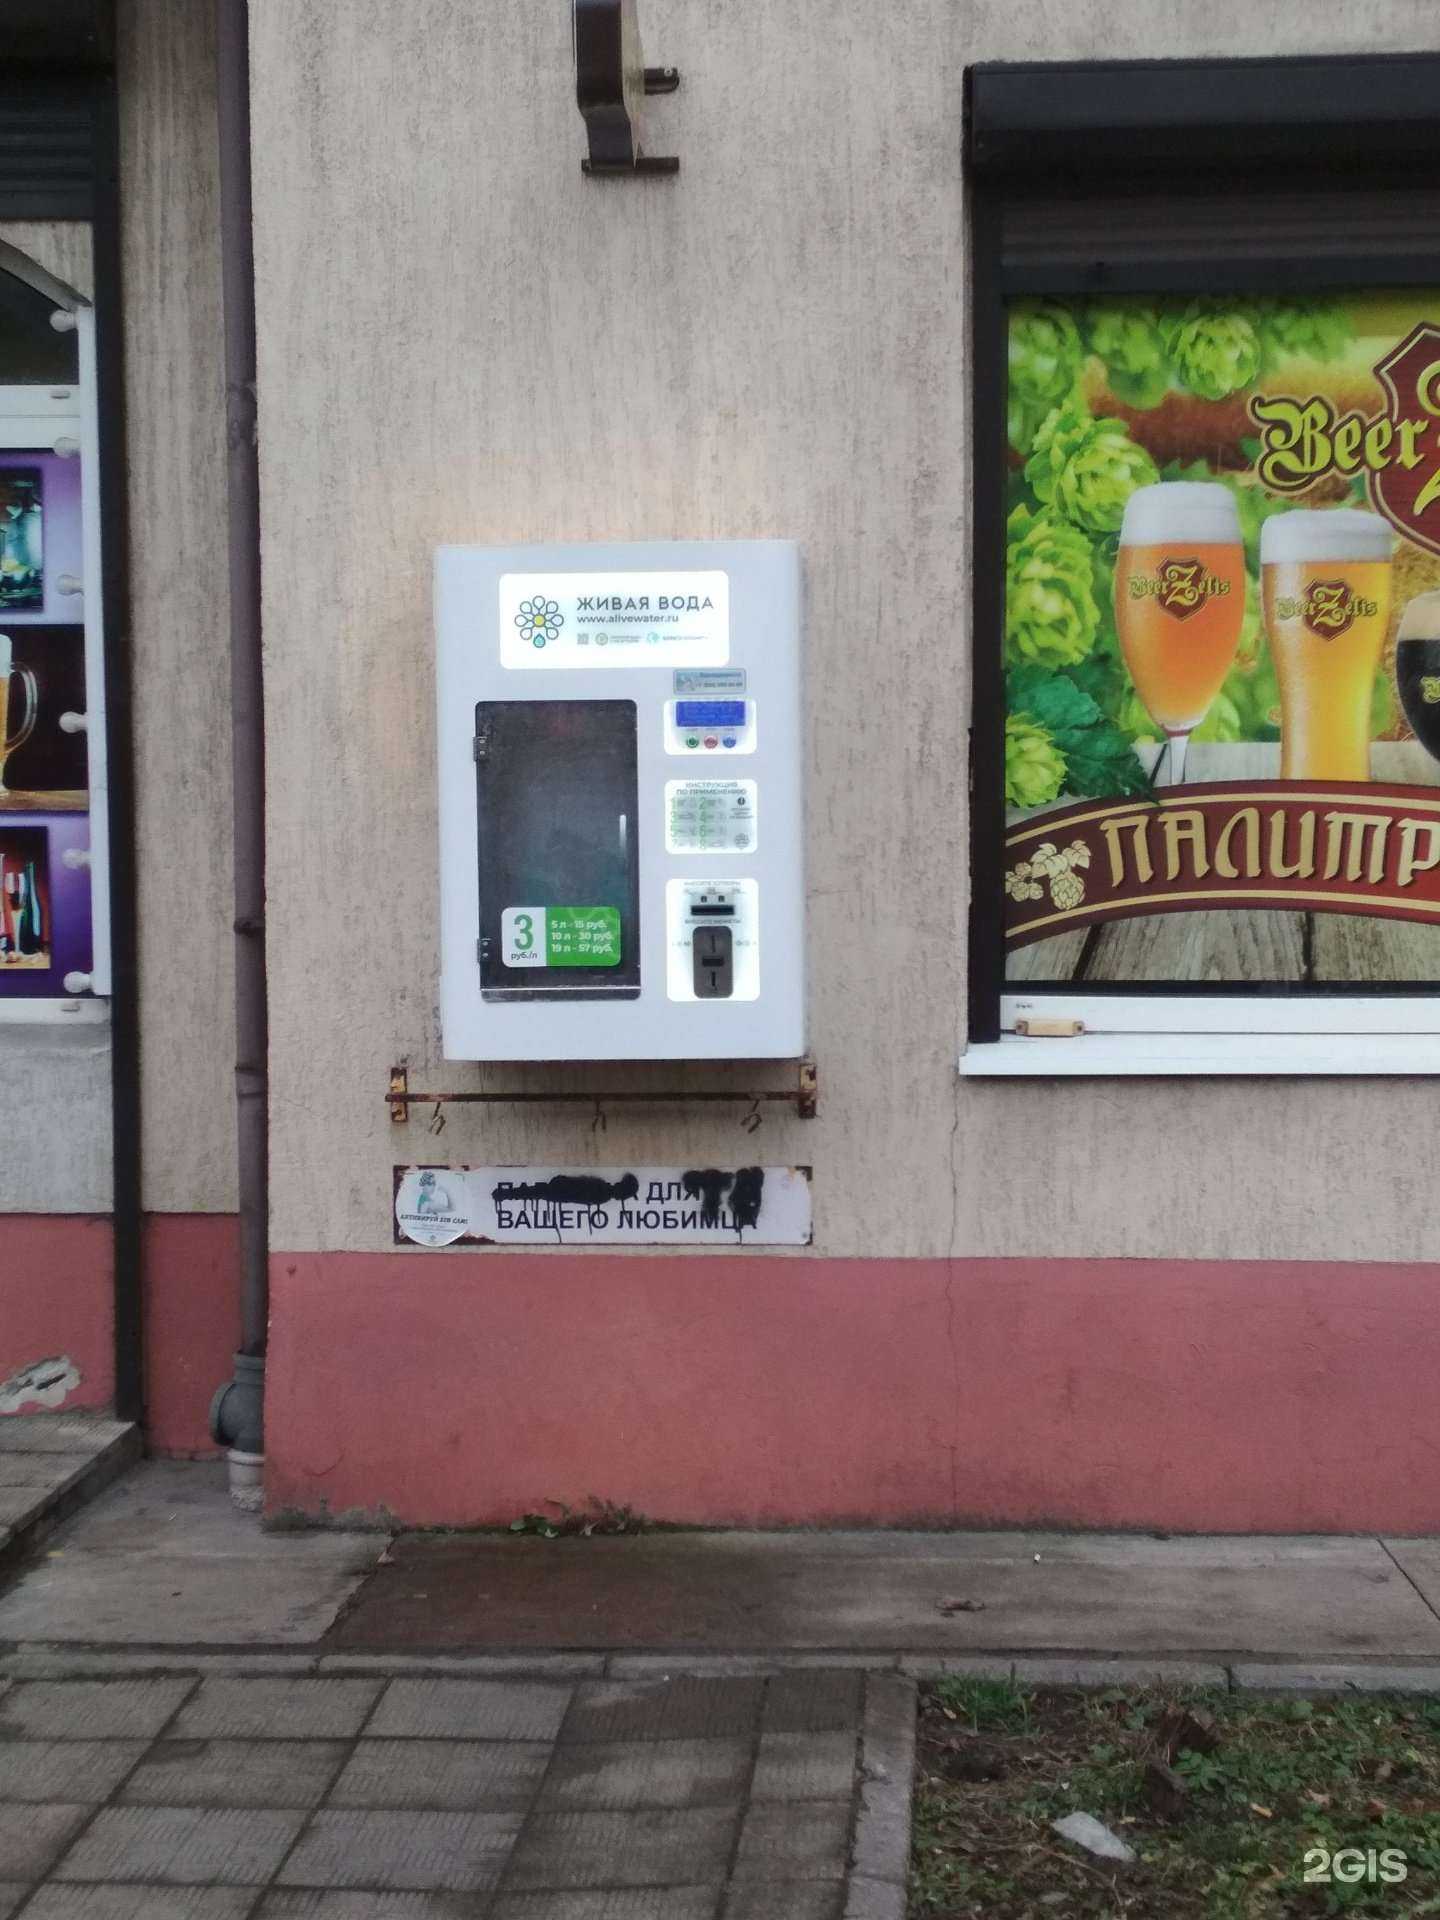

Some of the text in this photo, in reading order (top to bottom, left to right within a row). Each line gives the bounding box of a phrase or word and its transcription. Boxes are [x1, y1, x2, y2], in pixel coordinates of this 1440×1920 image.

[577, 595, 714, 612] ЖИВАЯ ВОДА
[577, 614, 679, 624] www.alivewater.ru
[1099, 806, 1440, 888] ПАЛИТР
[513, 914, 534, 950] 3
[552, 932, 562, 940] 10
[617, 1210, 757, 1232] ЛЮБИМЦ
